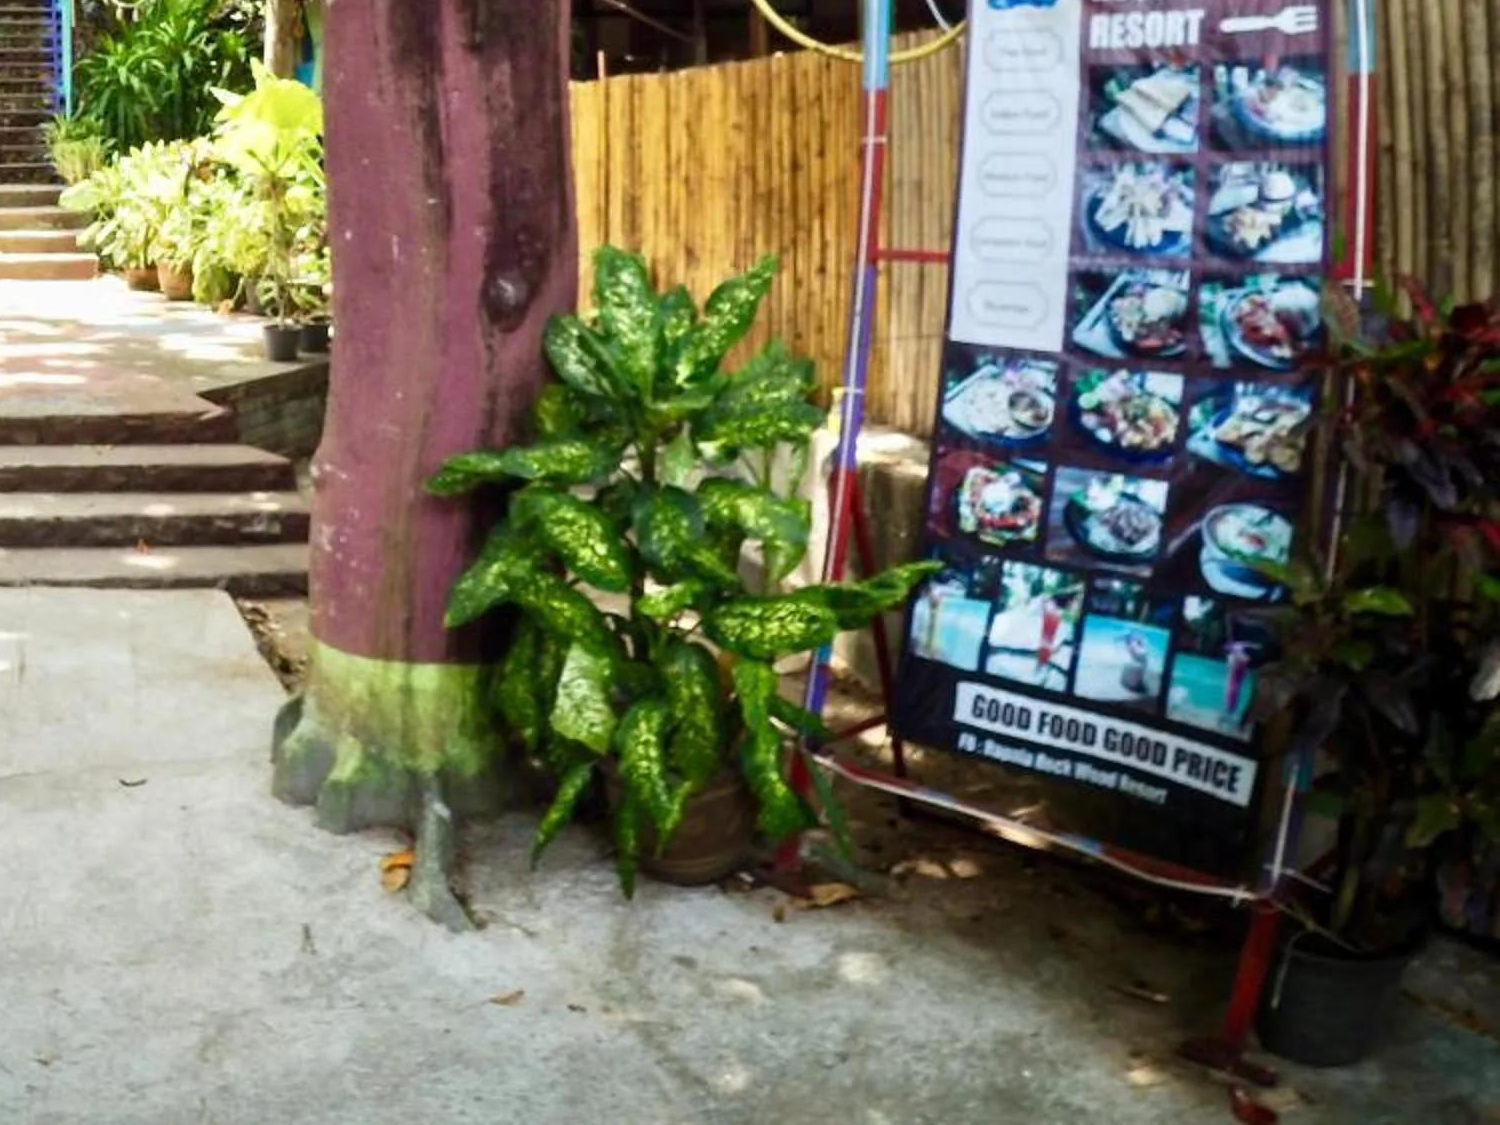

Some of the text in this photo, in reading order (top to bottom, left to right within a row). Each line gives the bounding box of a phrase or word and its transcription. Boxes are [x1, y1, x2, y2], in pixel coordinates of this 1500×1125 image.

[1088, 9, 1205, 49] RESORT
[971, 694, 1243, 794] GOOD FOOD GOOD PRICE
